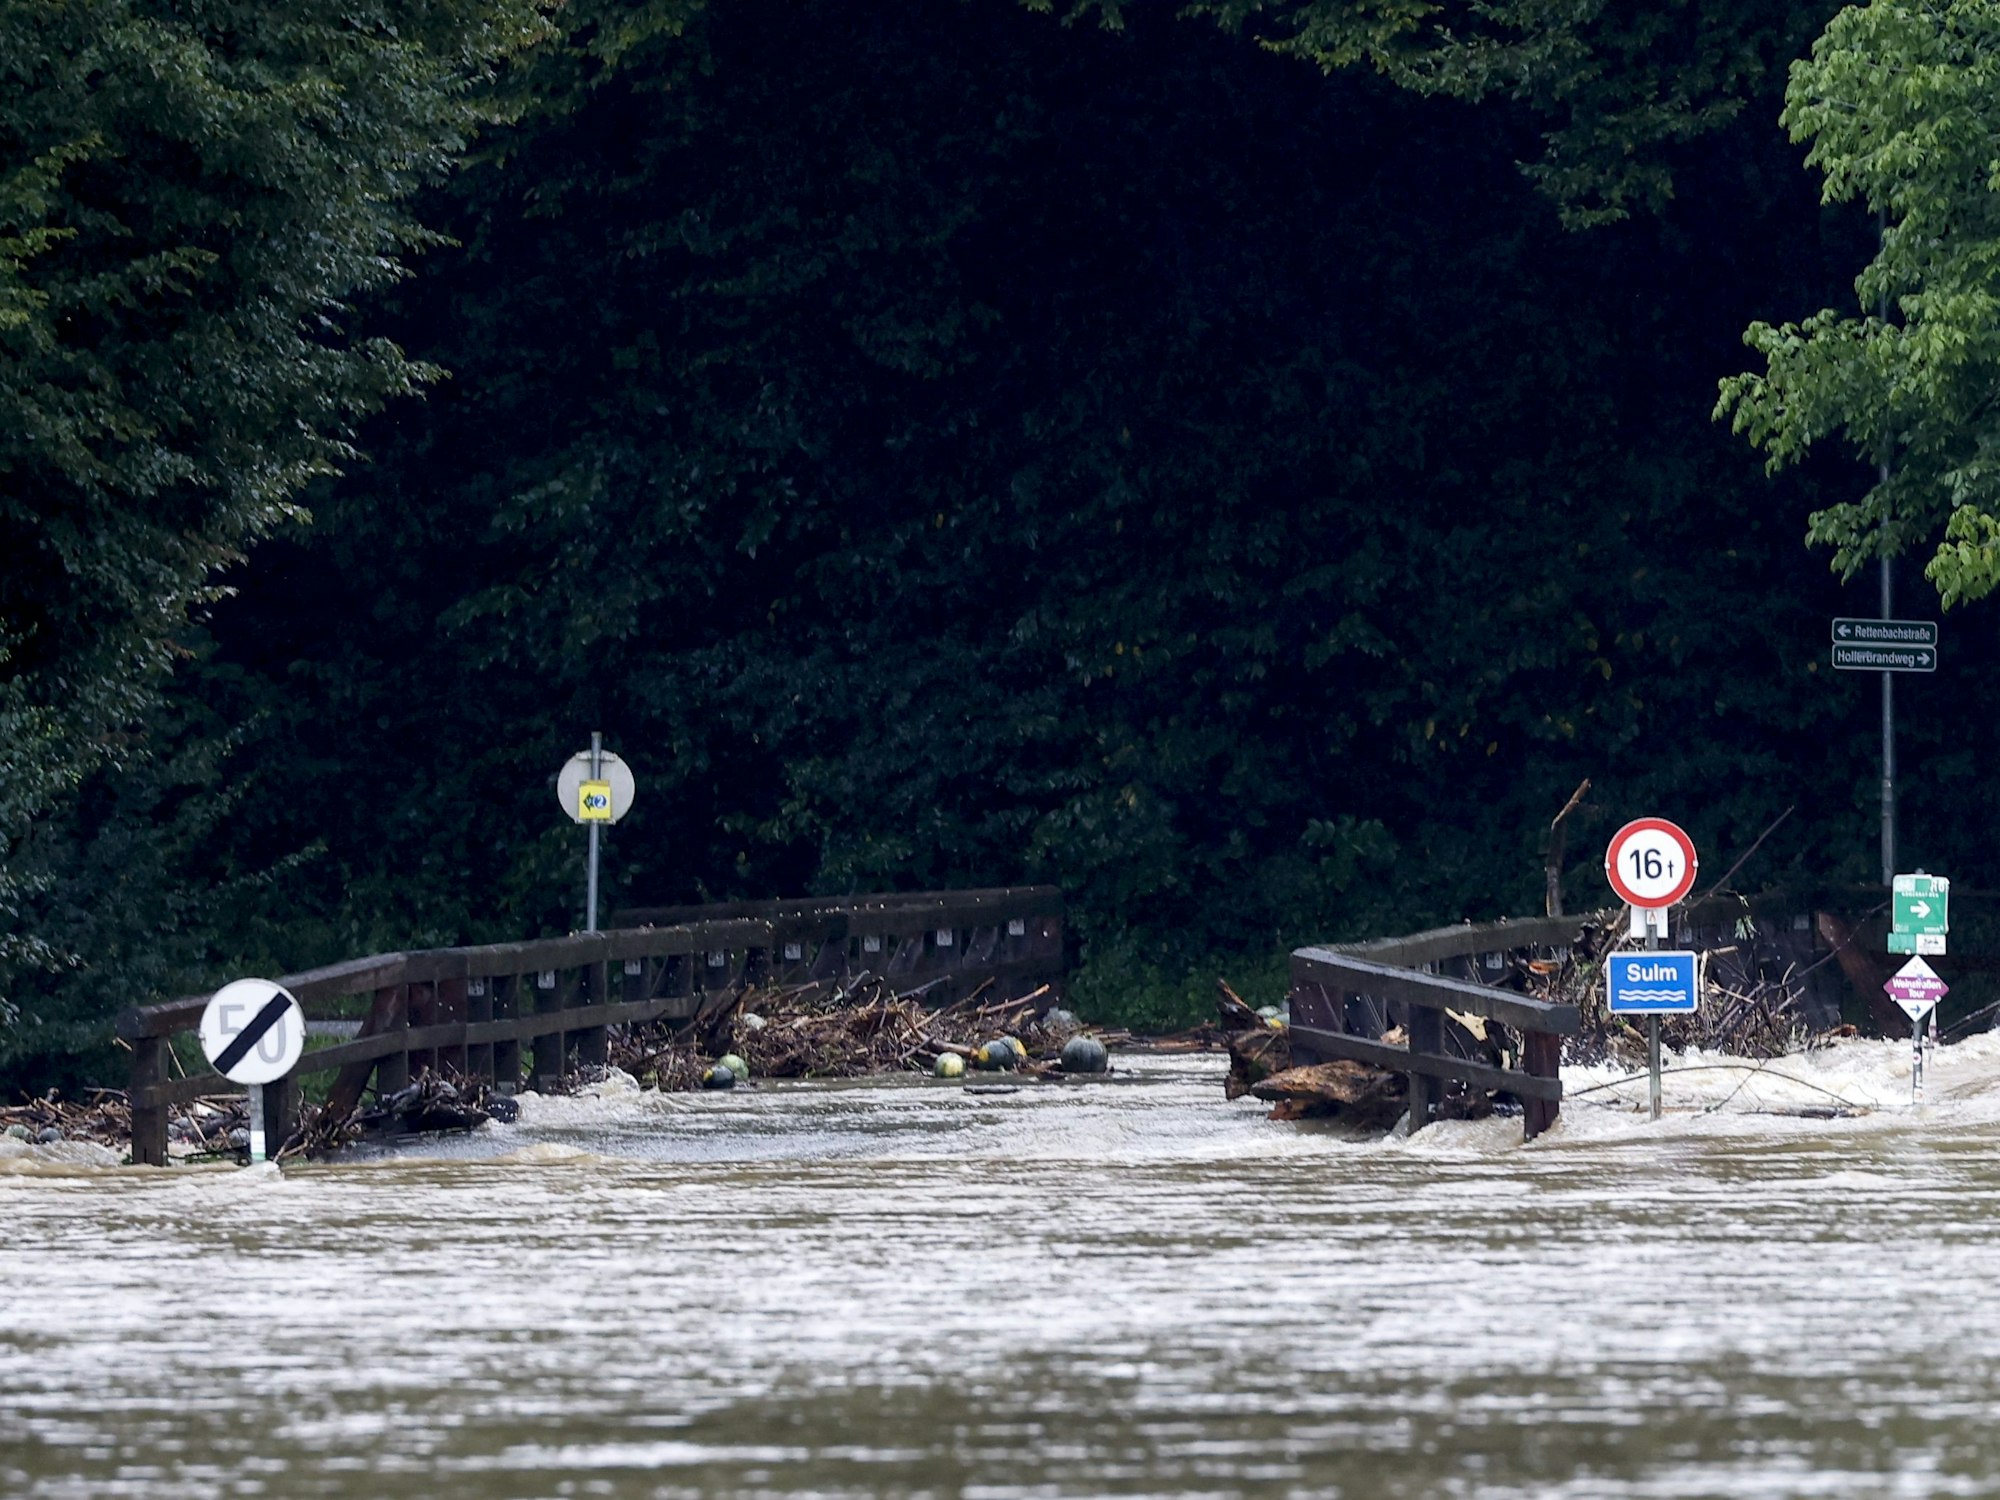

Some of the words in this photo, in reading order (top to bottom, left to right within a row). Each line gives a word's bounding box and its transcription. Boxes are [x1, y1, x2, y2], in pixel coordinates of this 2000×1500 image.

[1854, 625, 1931, 640] Rettenbachstraße
[1626, 963, 1678, 982] Sulm
[1908, 988, 1925, 999] Tour
